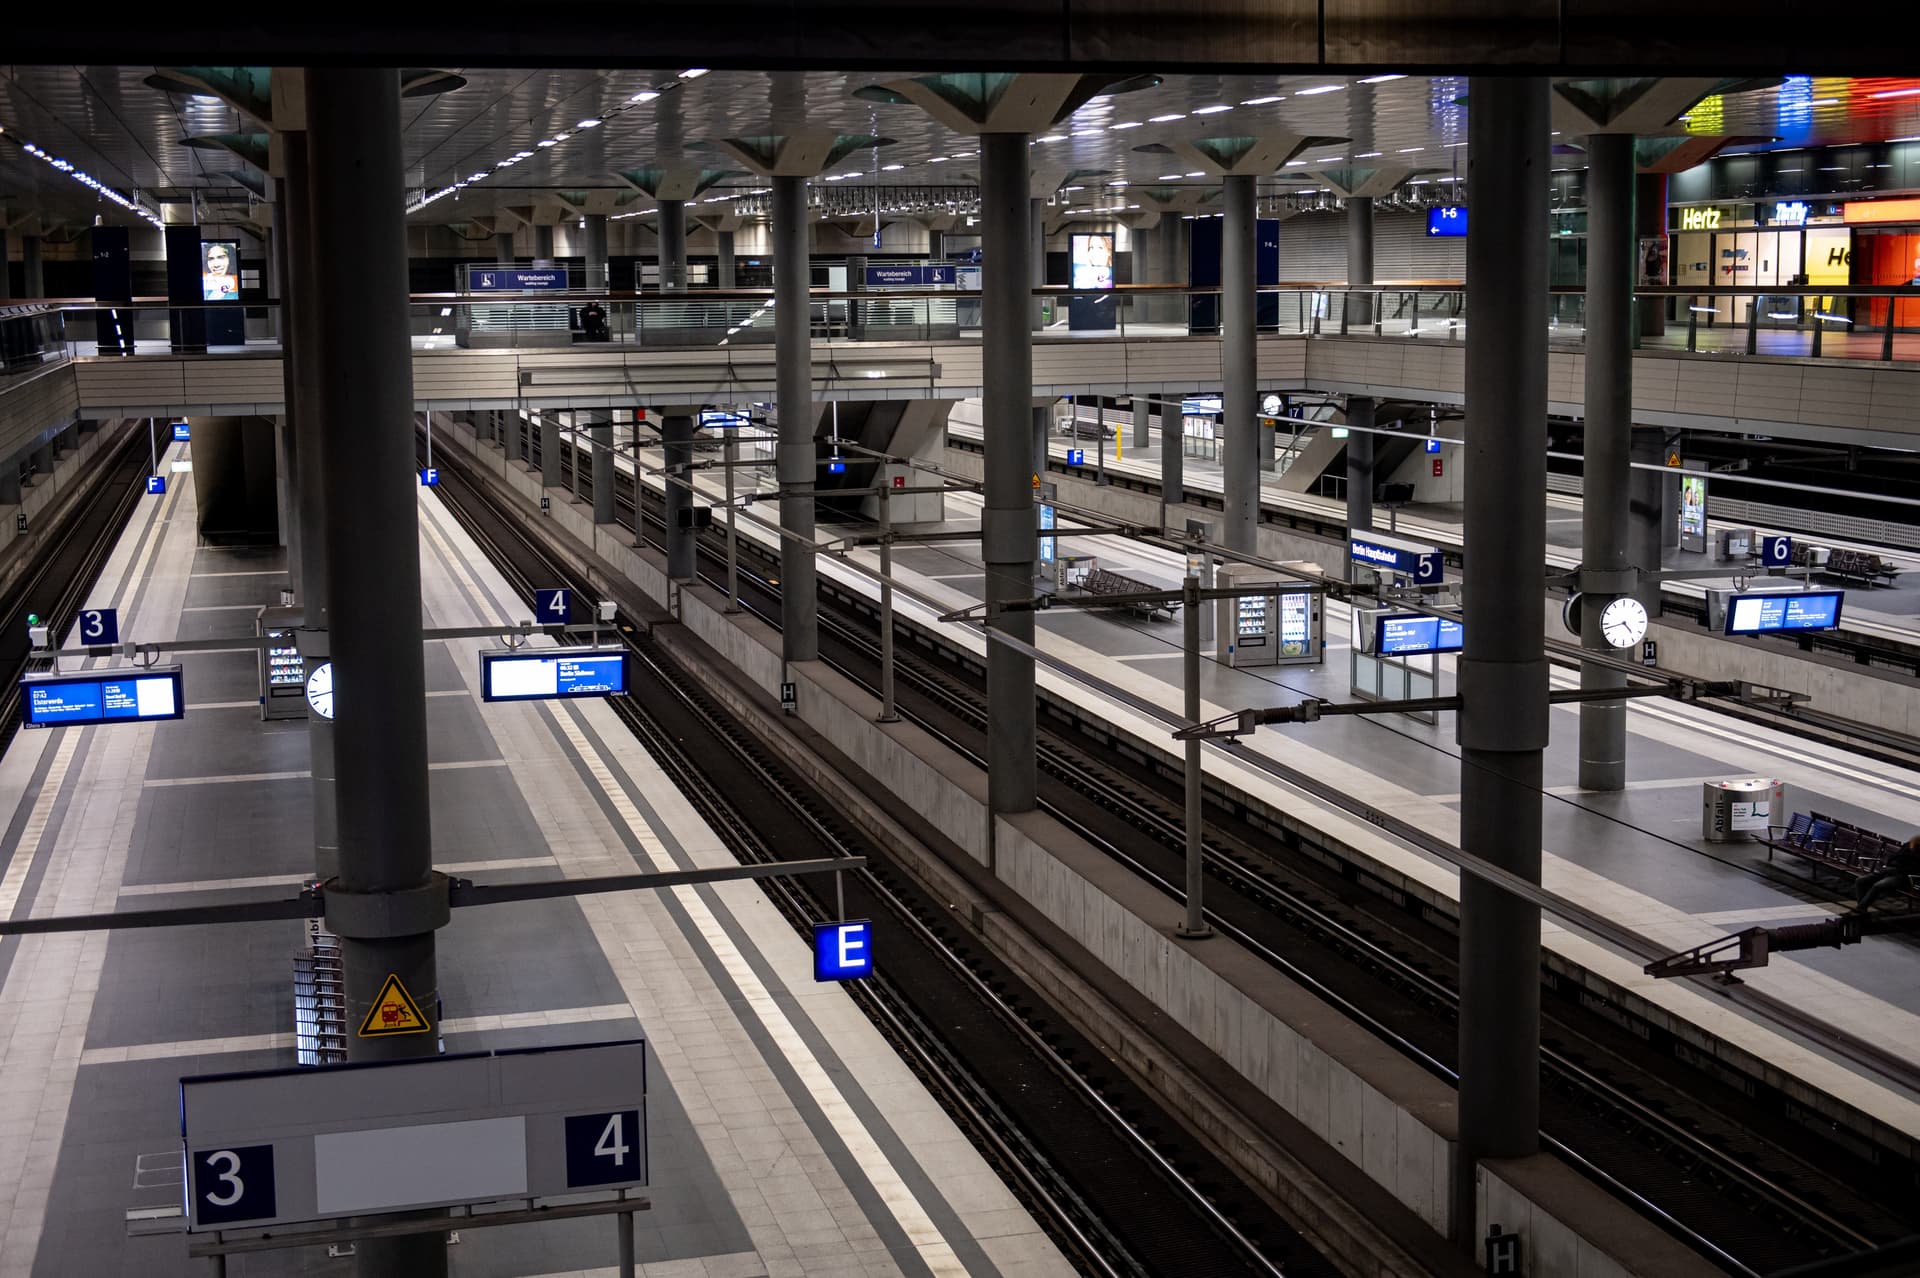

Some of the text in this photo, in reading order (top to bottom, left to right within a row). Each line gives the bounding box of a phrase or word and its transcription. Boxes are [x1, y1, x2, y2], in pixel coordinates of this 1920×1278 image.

[1441, 207, 1457, 219] 1-6
[1683, 207, 1721, 230] Hertz
[1293, 408, 1299, 417] 7
[1074, 450, 1082, 463] F
[148, 477, 158, 491] F
[427, 469, 437, 483] F
[1774, 537, 1788, 560] 6
[1419, 554, 1433, 577] 5
[549, 590, 566, 615] 4
[85, 610, 103, 637] 3
[1645, 643, 1655, 657] H
[783, 685, 794, 700] H
[1715, 802, 1725, 833] Abfall
[838, 924, 866, 967] E
[594, 1114, 629, 1166] 4
[206, 1150, 244, 1206] 3
[1493, 1240, 1514, 1274] H
